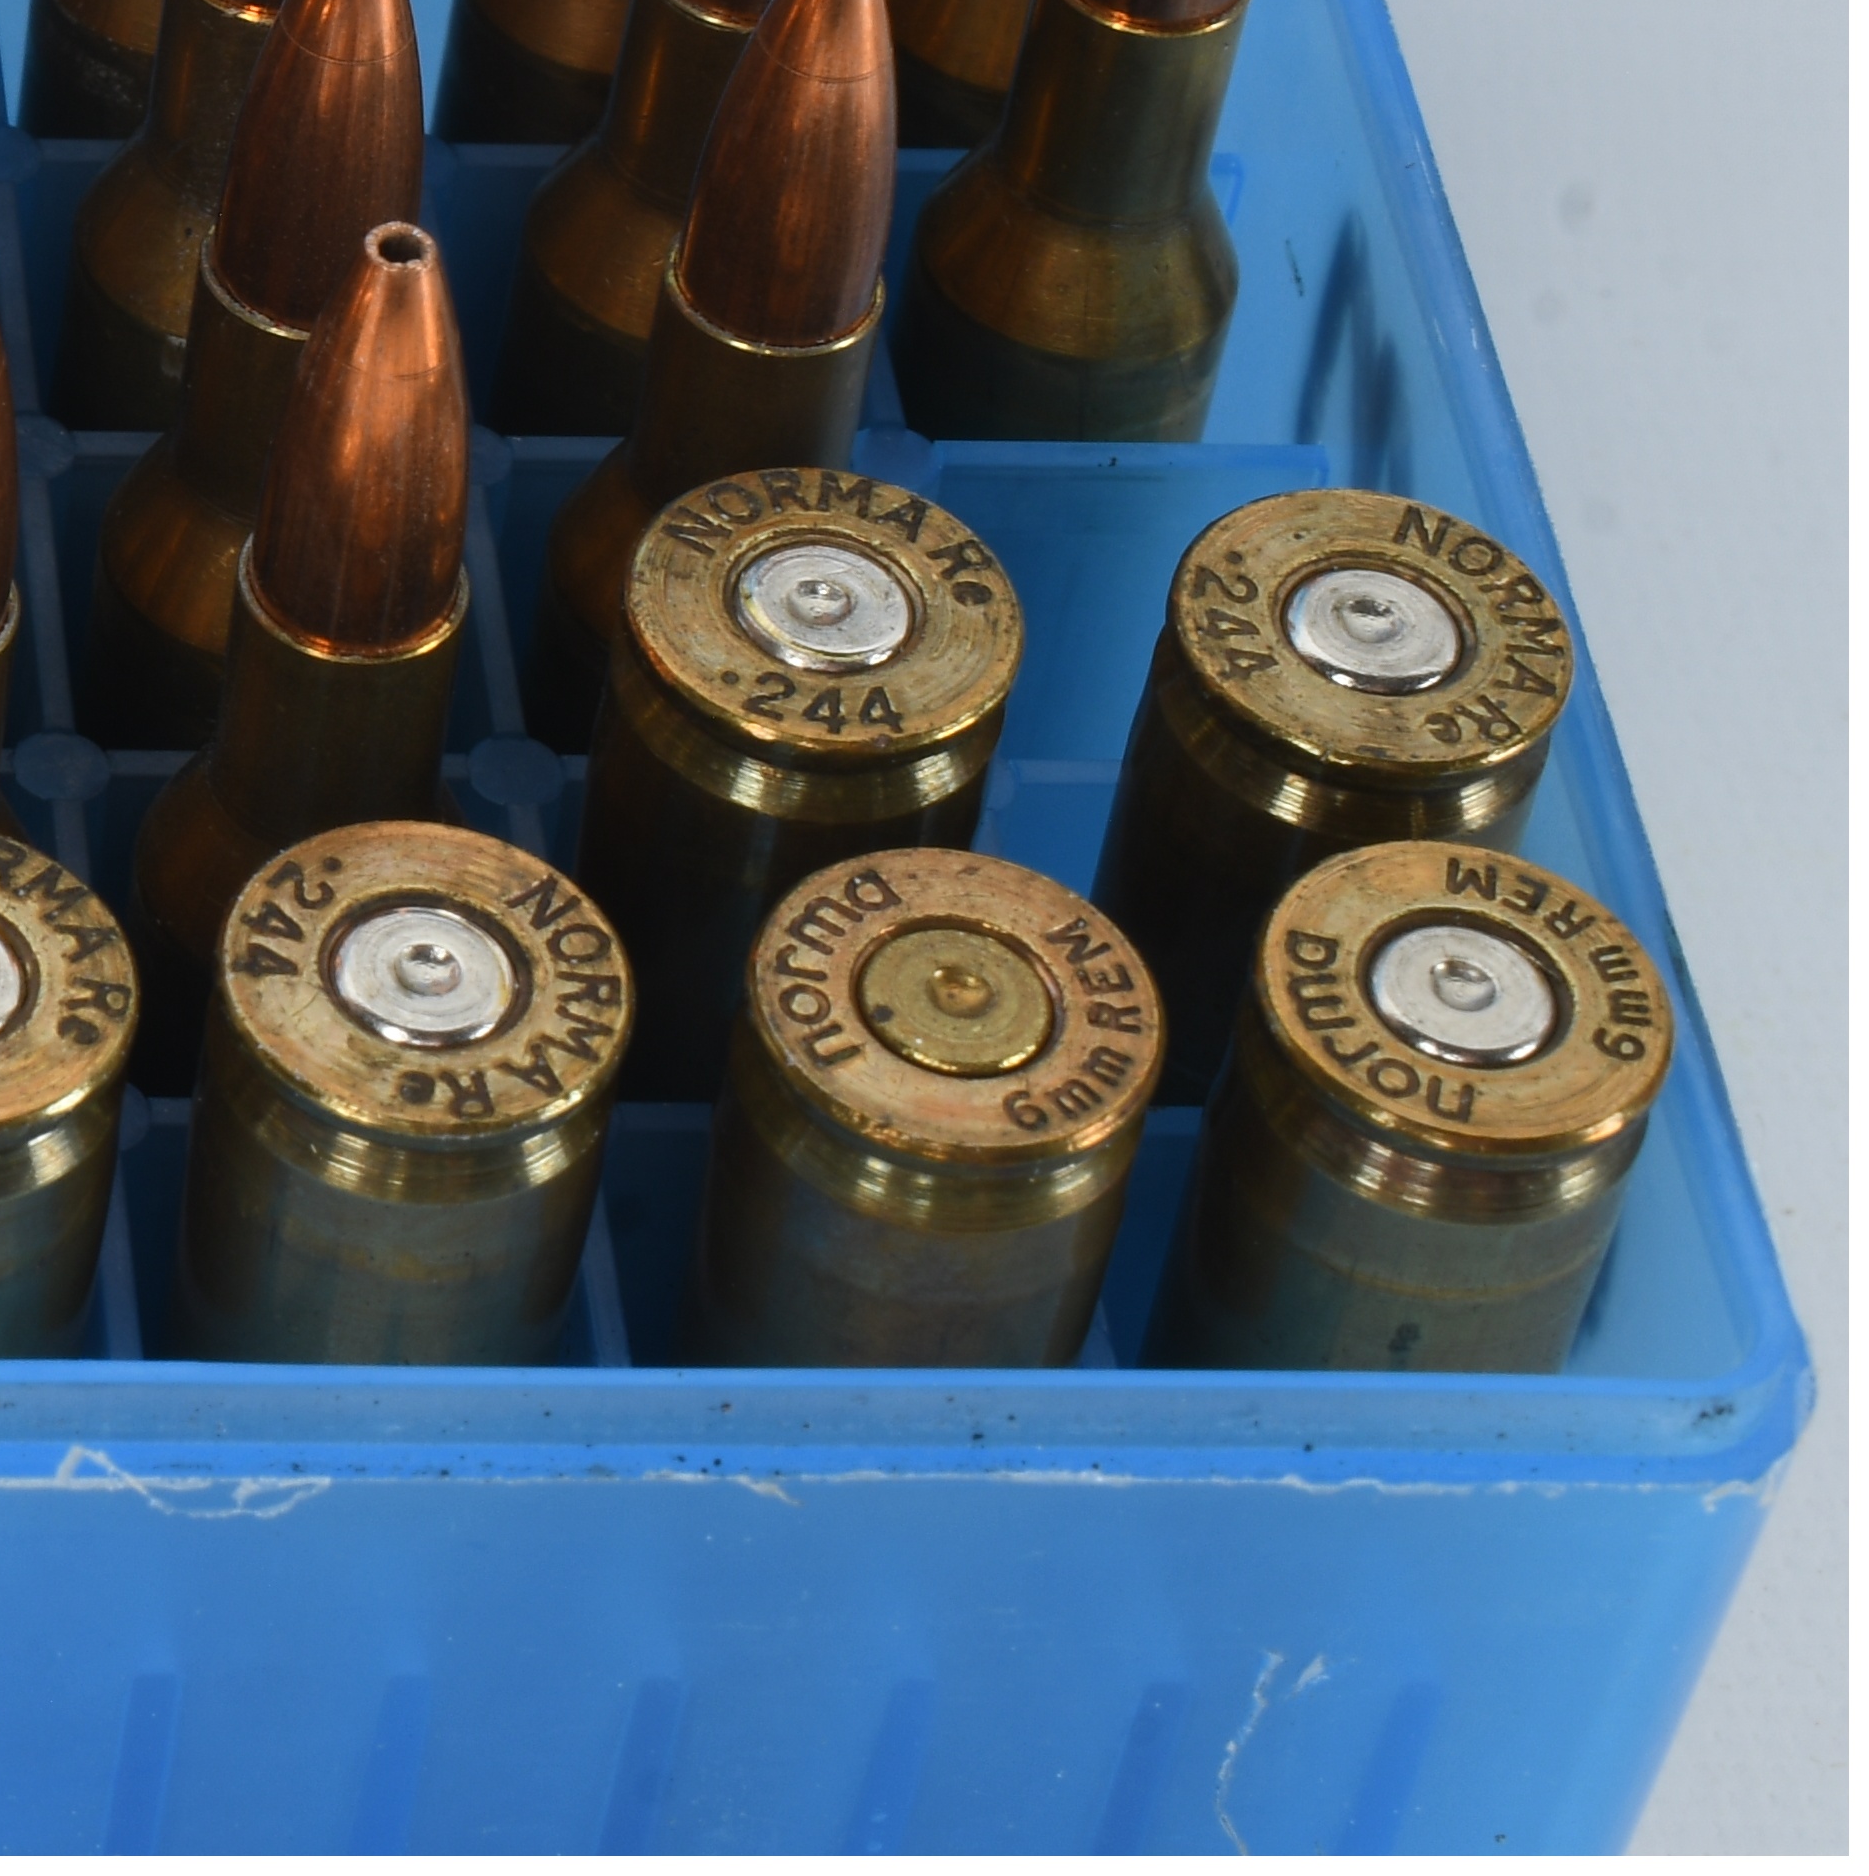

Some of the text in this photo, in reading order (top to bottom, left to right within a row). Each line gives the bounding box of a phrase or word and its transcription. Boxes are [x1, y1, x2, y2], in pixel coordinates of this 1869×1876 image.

[662, 469, 934, 561] NORMA
[1390, 503, 1566, 698] NORMA
[719, 669, 906, 737] .244
[1188, 549, 1281, 683] .244
[229, 854, 344, 980] .244
[495, 872, 623, 1101] NORMA
[774, 866, 904, 1070] norma
[1443, 856, 1654, 1064] 6mm REM
[1000, 914, 1144, 1133] 6mm REM
[1283, 927, 1477, 1125] norma
